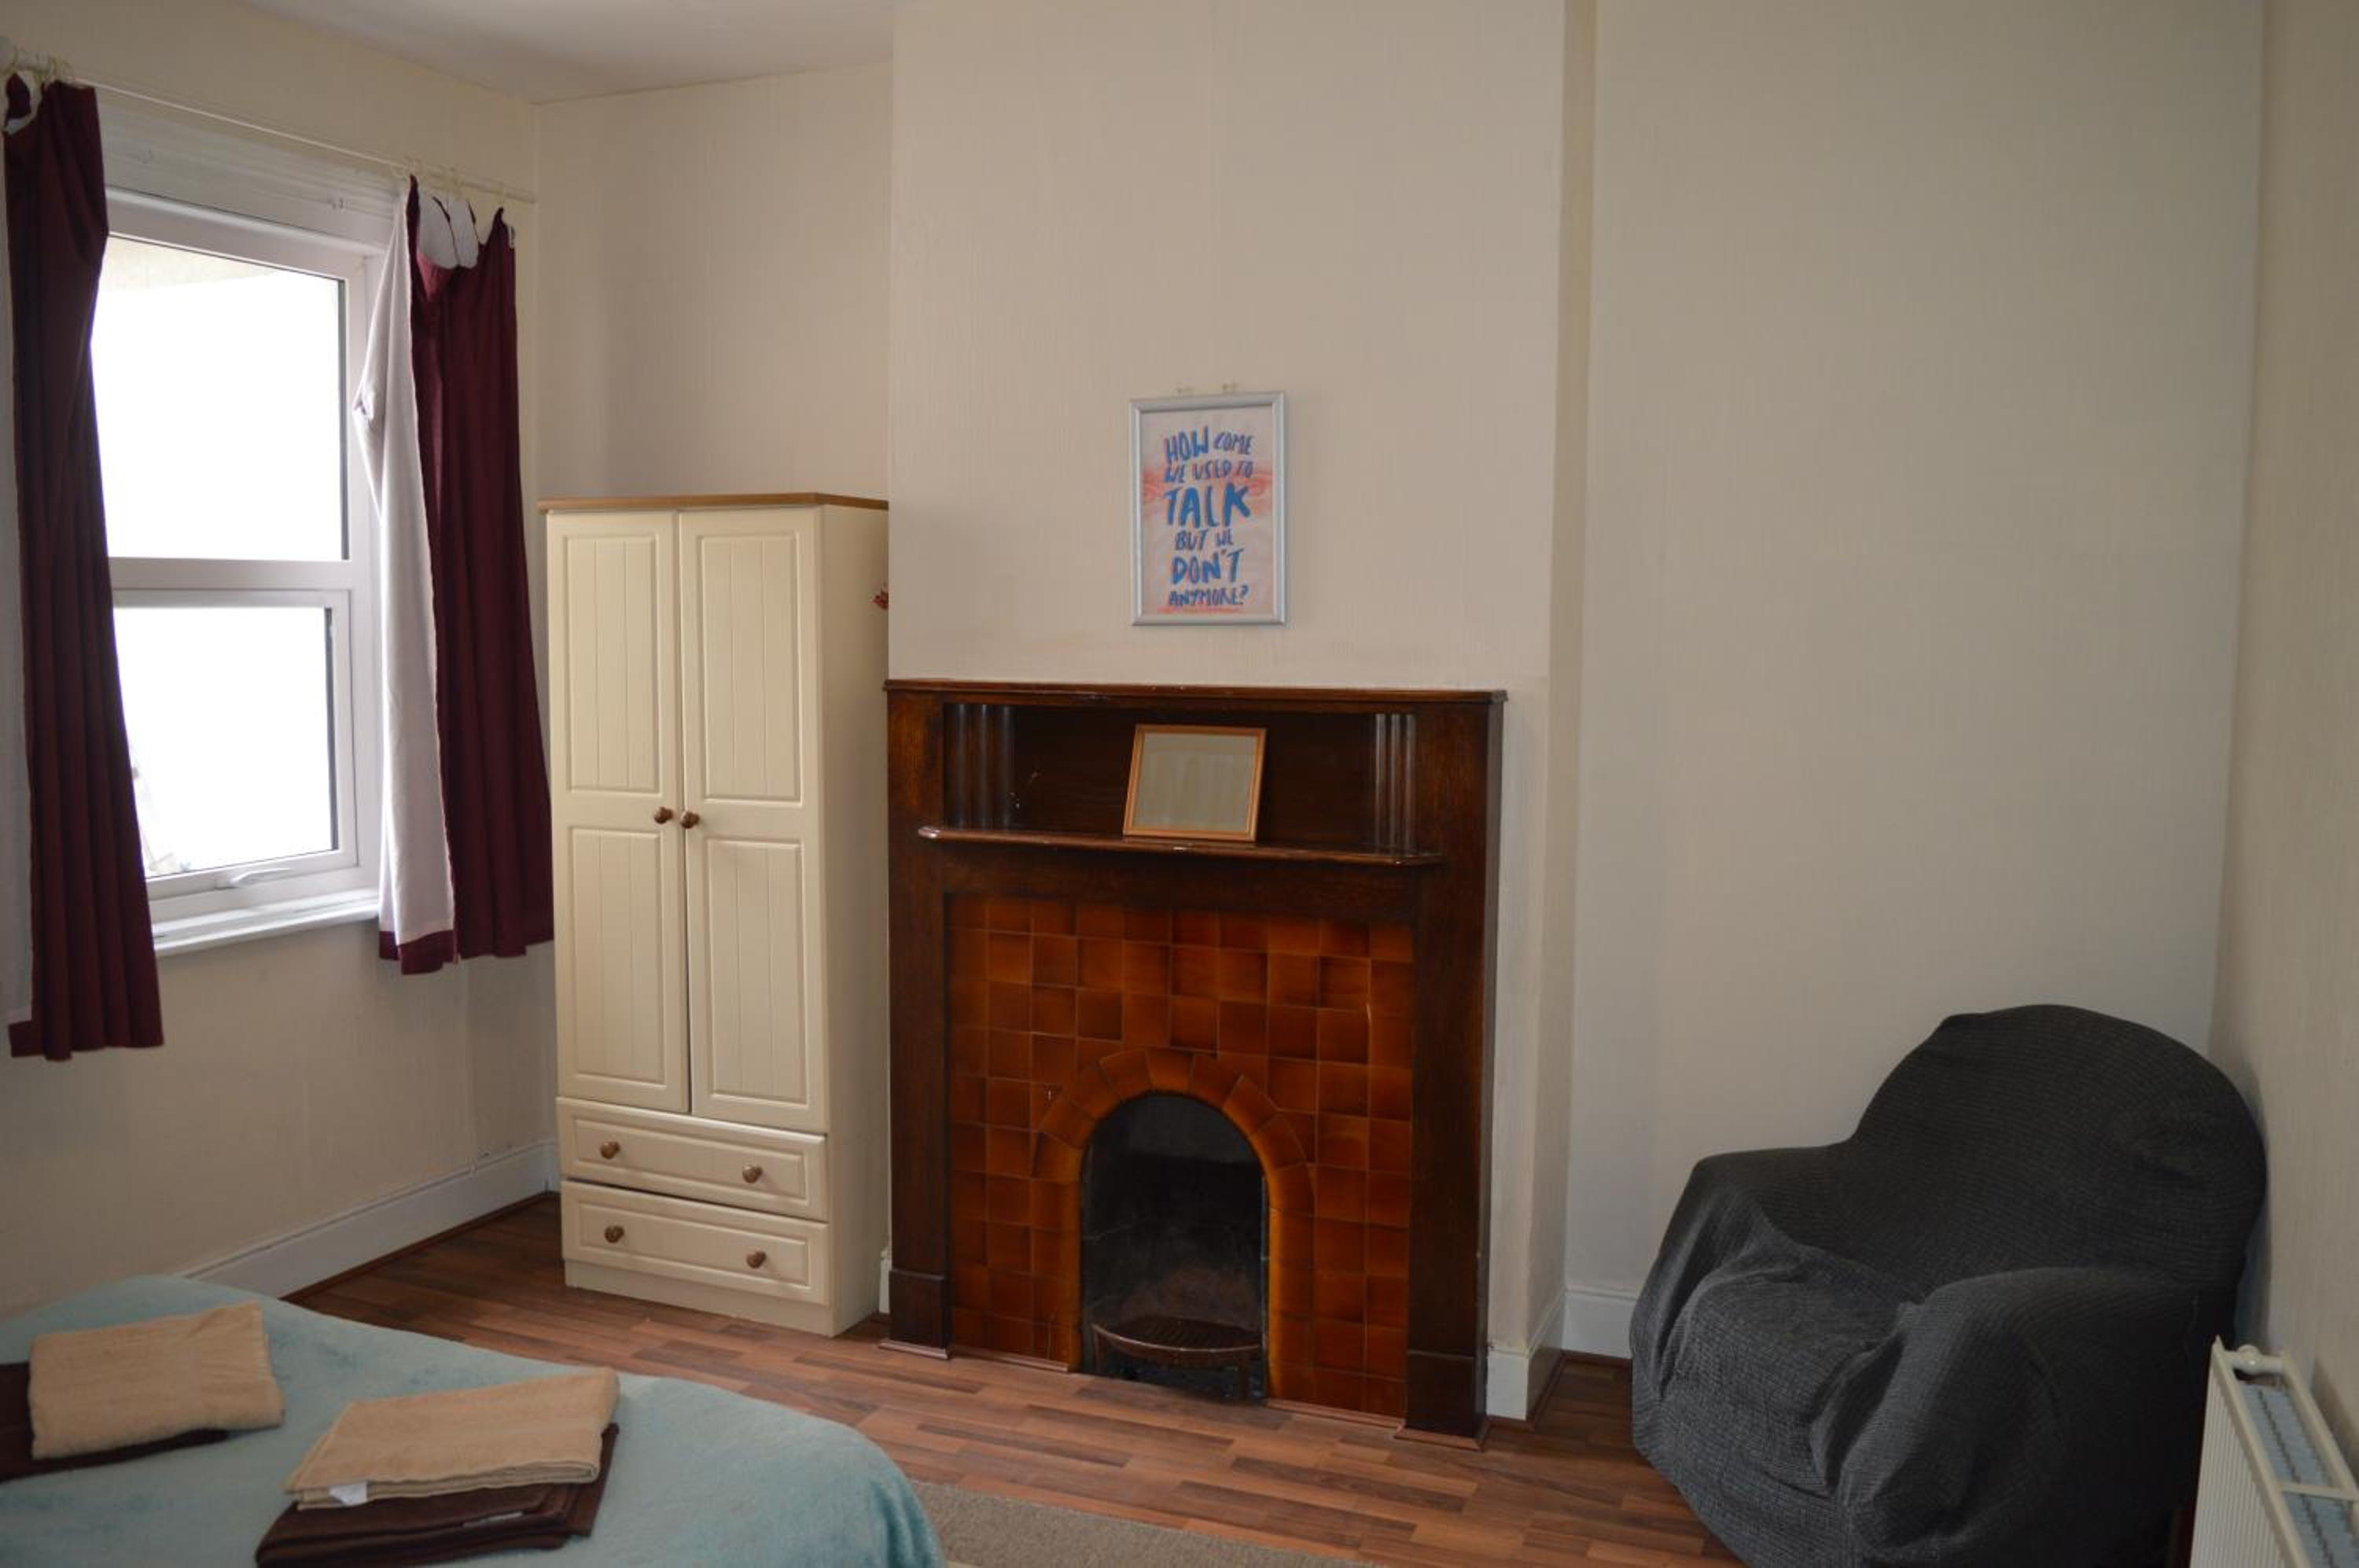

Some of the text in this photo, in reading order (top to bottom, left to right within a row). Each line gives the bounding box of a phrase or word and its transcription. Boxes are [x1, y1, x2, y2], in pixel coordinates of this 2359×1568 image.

[1165, 426, 1253, 464] HOW COME
[1165, 460, 1253, 483] WE USED TO
[1165, 482, 1251, 528] TALK
[1175, 528, 1234, 550] BUT WE
[1172, 548, 1245, 583] DON'T
[1169, 585, 1249, 606] ANYMORE?
